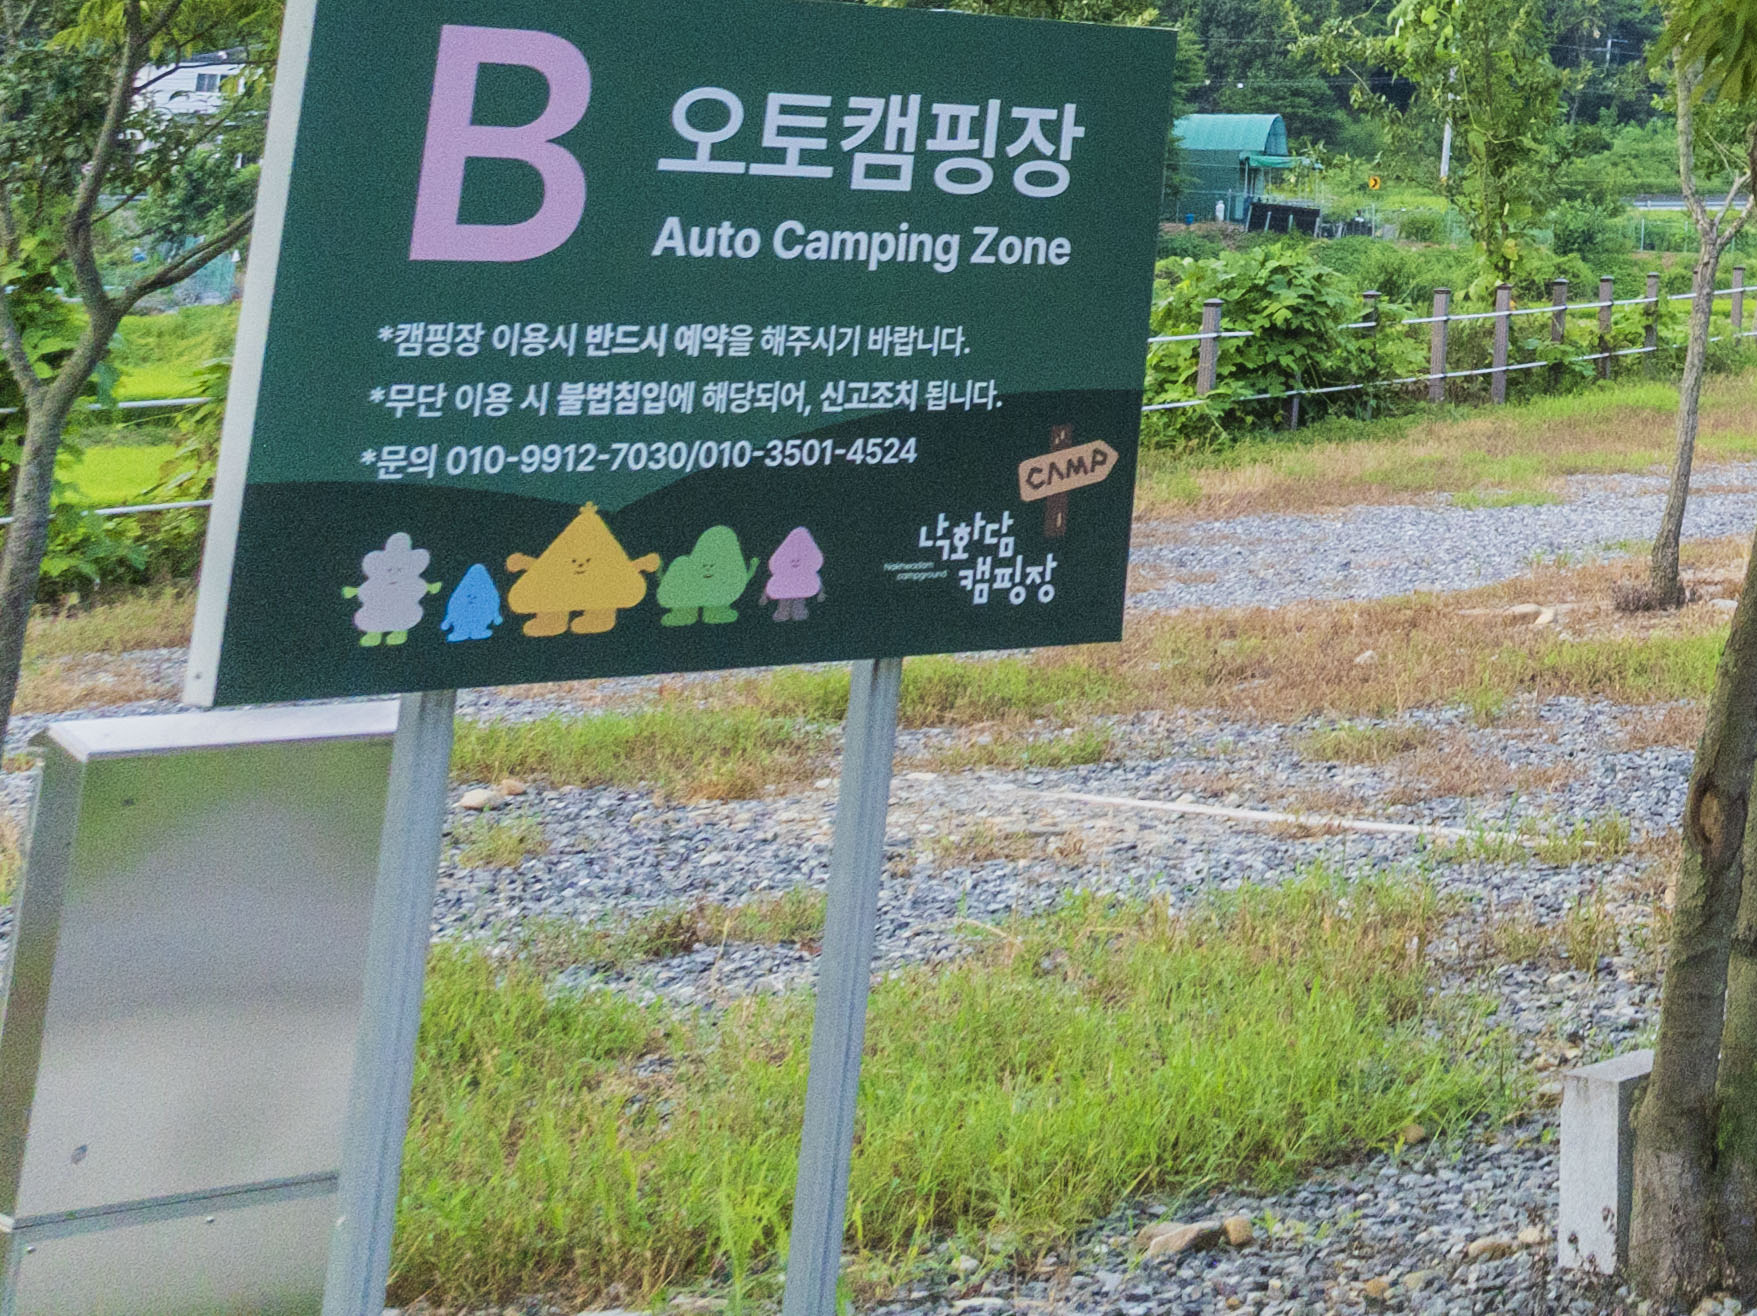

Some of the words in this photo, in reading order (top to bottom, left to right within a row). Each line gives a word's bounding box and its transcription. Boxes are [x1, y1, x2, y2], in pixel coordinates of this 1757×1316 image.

[409, 24, 591, 262] B
[658, 87, 1085, 197] 오토캠핑장
[652, 217, 760, 258] Auto
[773, 220, 960, 272] Camping
[970, 226, 1071, 265] Zone
[492, 323, 577, 356] 이용시
[586, 323, 668, 357] 반드시
[674, 324, 754, 357] 예약을
[761, 325, 860, 356] 해주시기
[868, 326, 970, 356] 바랍니다.
[455, 383, 513, 417] 이용
[520, 382, 549, 416] 시
[557, 381, 695, 415] 불법침입에
[702, 381, 811, 416] 해당되어,
[820, 380, 919, 412] 신고조치
[925, 380, 1002, 410] 됩니다.
[446, 438, 917, 475] 010-9912-7030/010-3501-4524
[1025, 447, 1108, 490] CAMP
[919, 511, 1014, 560] 낙화담
[958, 552, 1057, 604] 캠핑장
